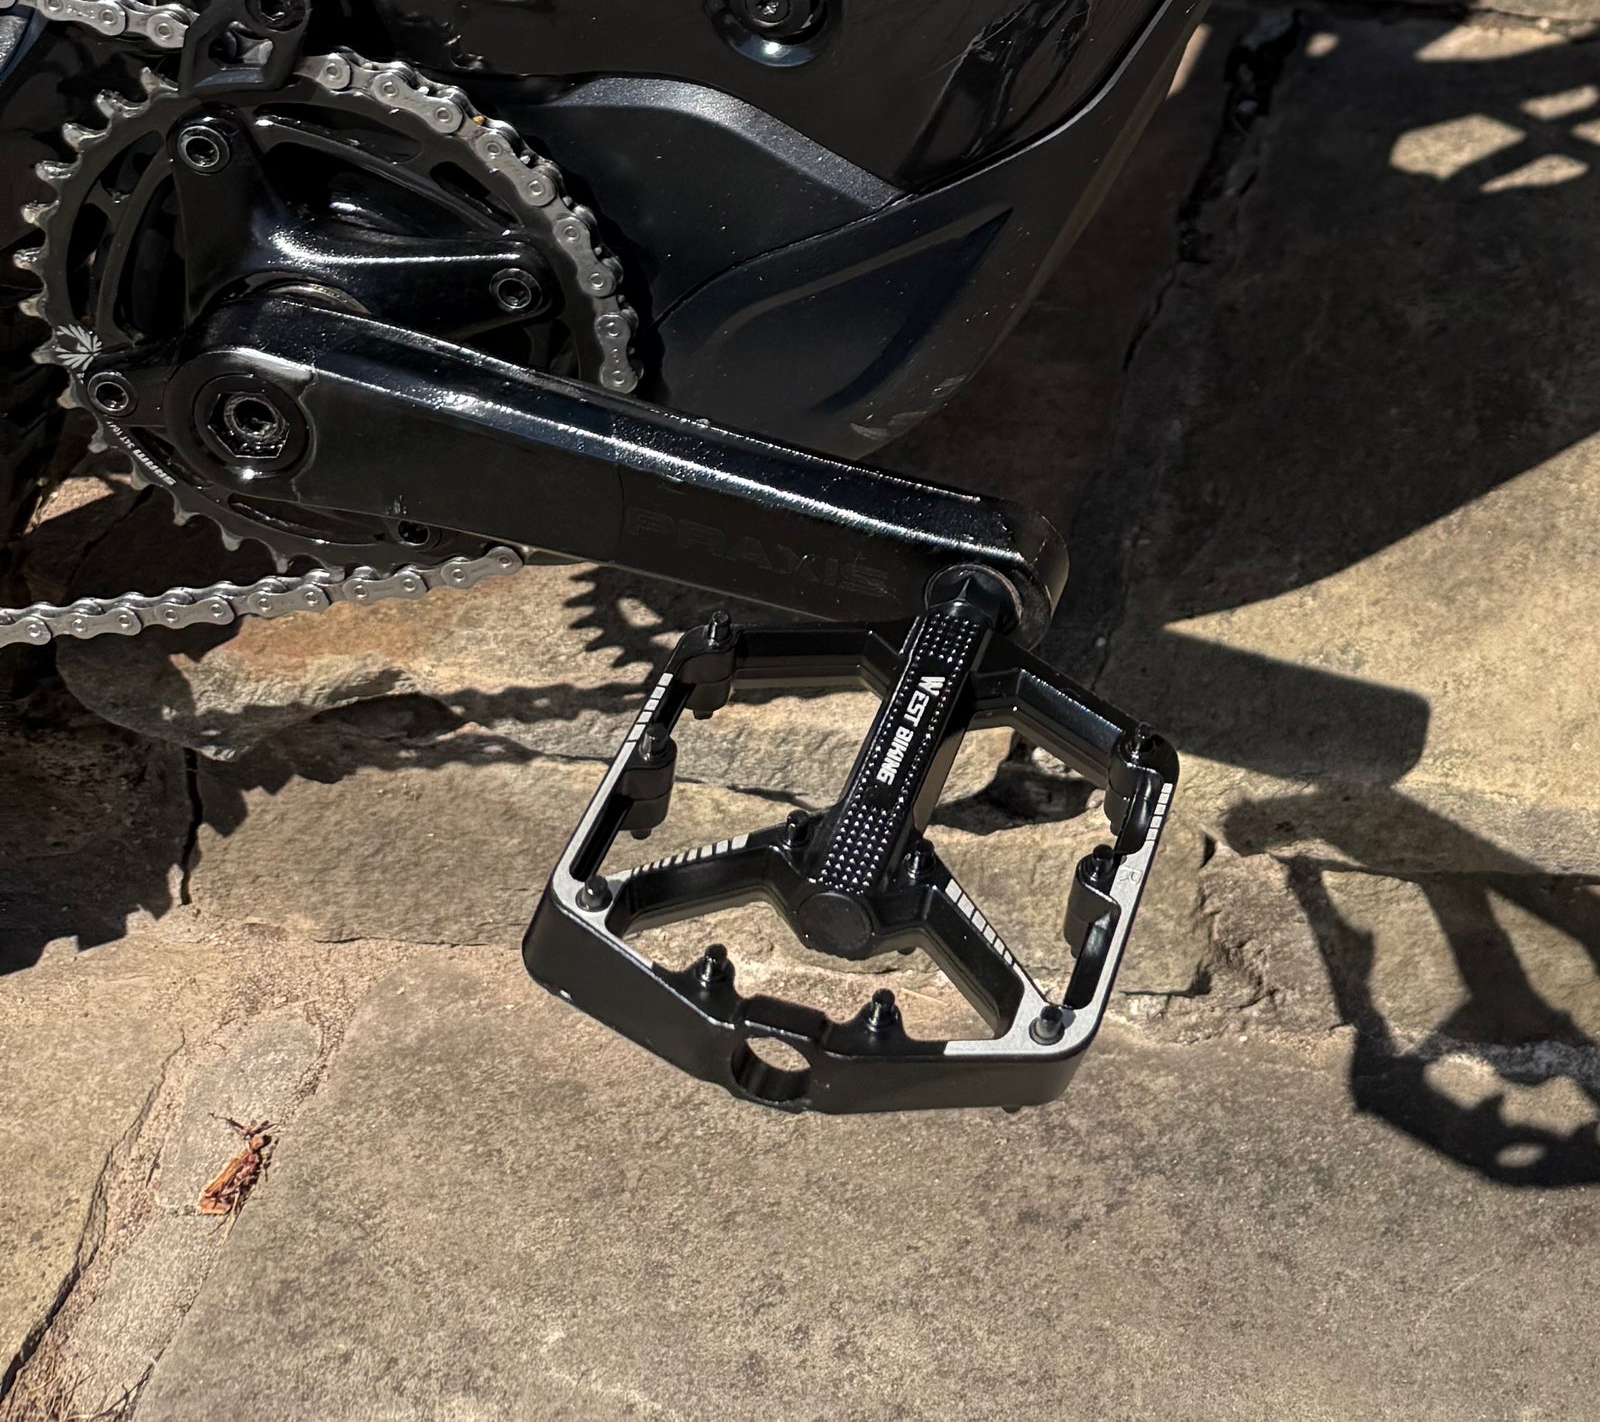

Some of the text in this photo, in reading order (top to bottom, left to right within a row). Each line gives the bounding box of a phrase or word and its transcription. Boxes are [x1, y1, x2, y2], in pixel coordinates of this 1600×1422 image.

[133, 449, 177, 486] SRAM
[626, 505, 889, 598] PRAXIS
[876, 676, 946, 786] WEST BIKING
